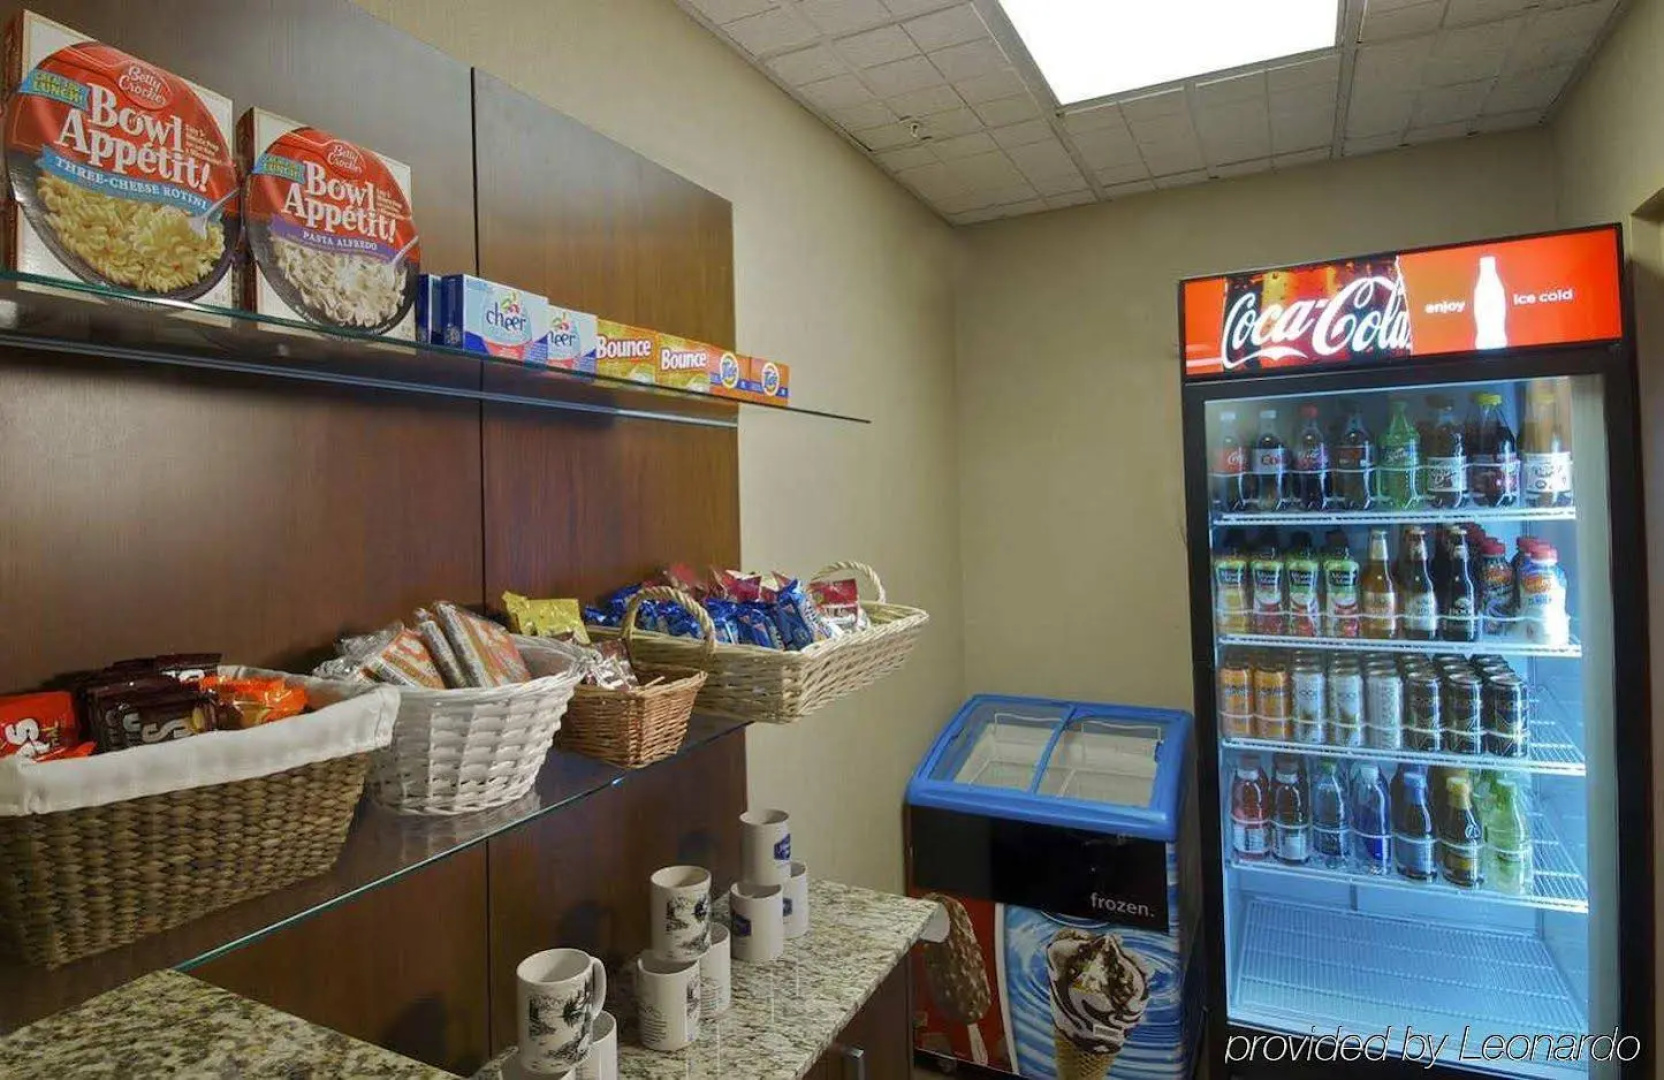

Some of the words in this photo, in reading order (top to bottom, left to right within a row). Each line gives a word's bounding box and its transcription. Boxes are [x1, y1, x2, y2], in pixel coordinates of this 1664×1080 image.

[129, 66, 161, 93] Betty
[86, 83, 182, 152] Bowl
[56, 157, 160, 195] THREE-CHEESE
[163, 188, 208, 210] ROTINI
[303, 160, 375, 210] Bowl
[302, 231, 334, 247] PASTA
[336, 238, 378, 251] ALFREDO
[1425, 300, 1466, 315] enjoy
[1513, 293, 1536, 305] ice
[1539, 289, 1574, 303] cold
[486, 302, 526, 331] cheer
[1221, 276, 1413, 369] Coca-Cola
[596, 335, 651, 358] Bounce
[661, 349, 707, 370] Bounce
[1090, 892, 1155, 917] frozen.
